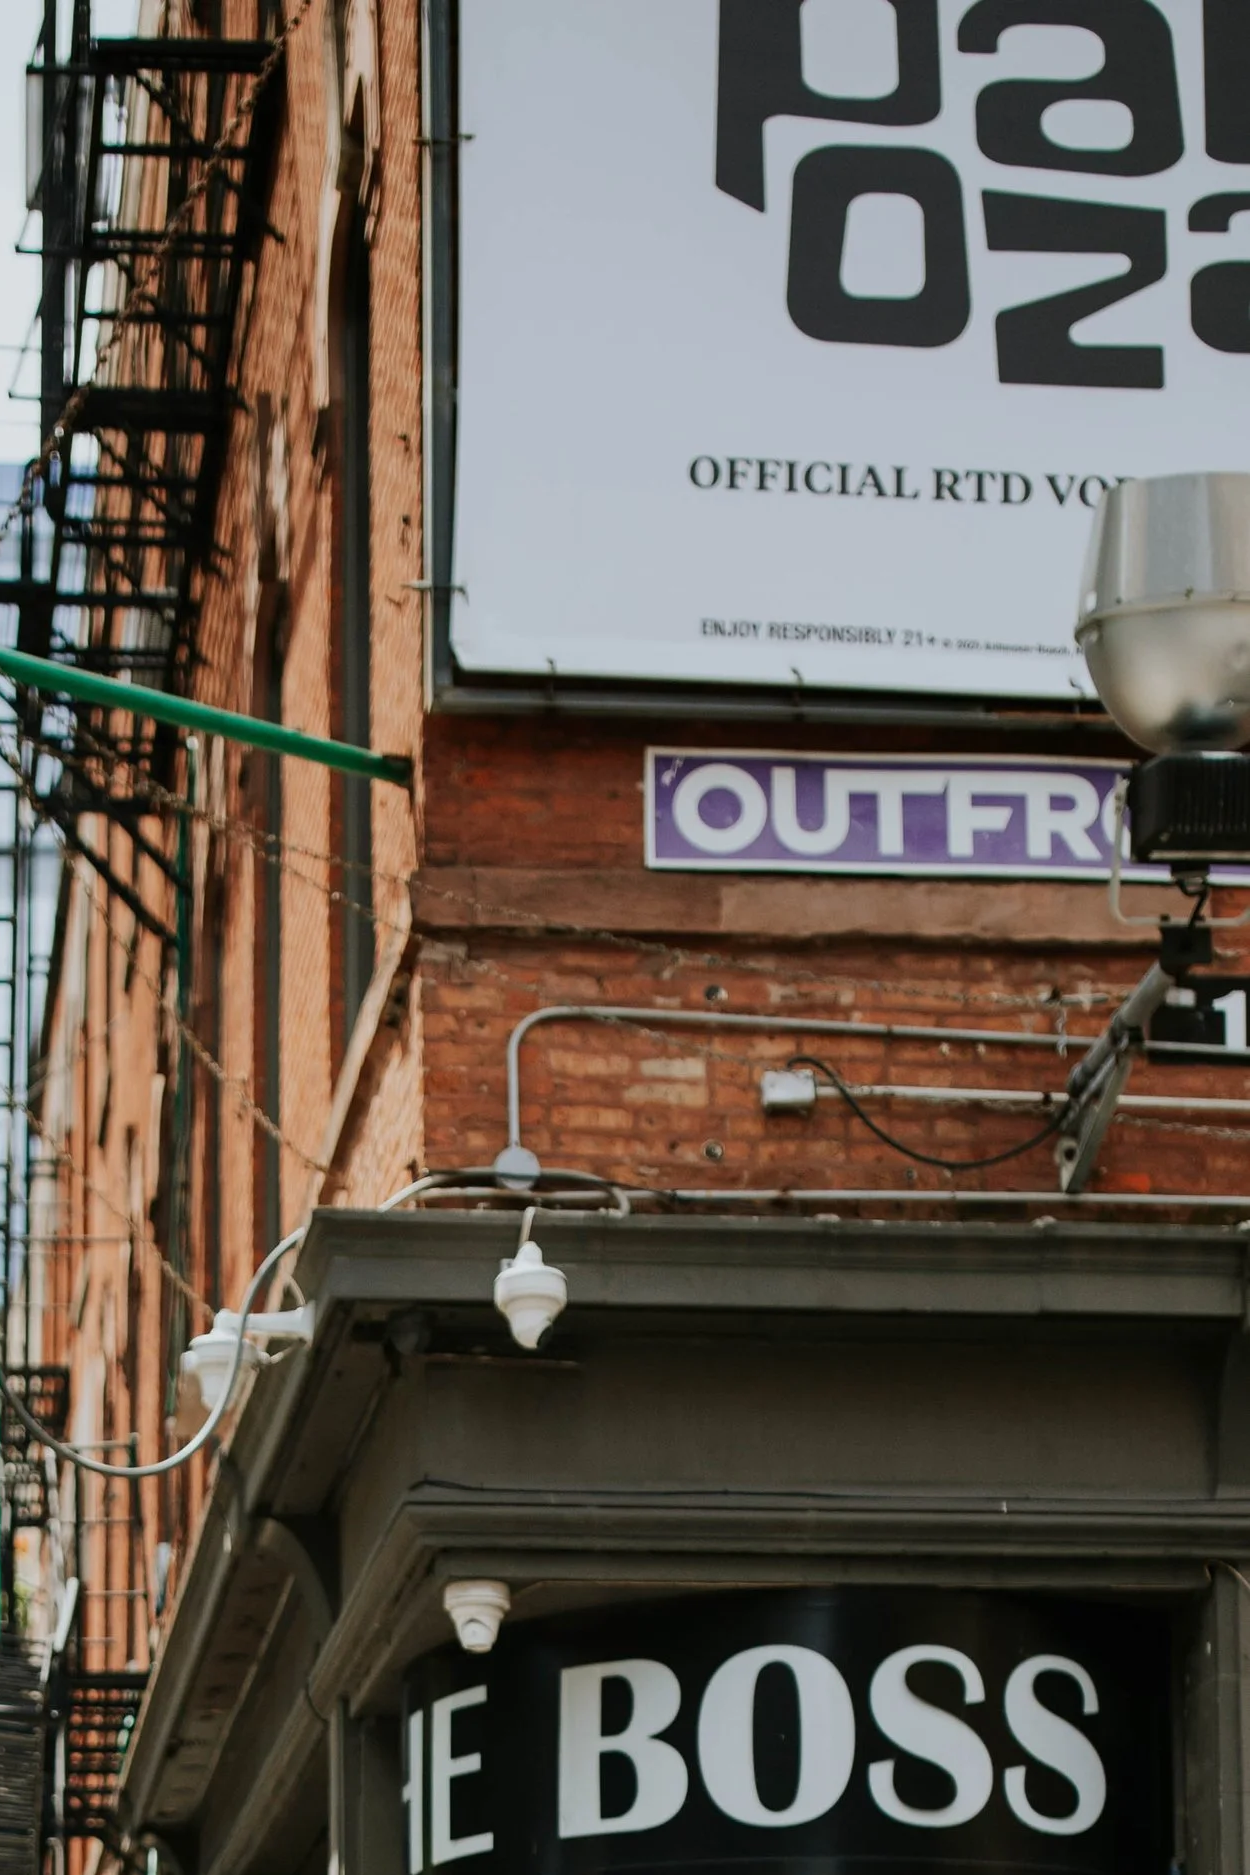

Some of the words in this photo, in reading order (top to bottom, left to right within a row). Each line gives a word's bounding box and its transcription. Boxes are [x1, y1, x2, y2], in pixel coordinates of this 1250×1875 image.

[689, 455, 920, 501] OFFICIAL
[932, 467, 1033, 505] RTD
[1045, 475, 1136, 508] VO
[701, 618, 762, 639] ENJOY
[768, 621, 897, 646] RESPONSIBLY
[672, 762, 1129, 861] OUTFR
[558, 1643, 1108, 1839] BOSS
